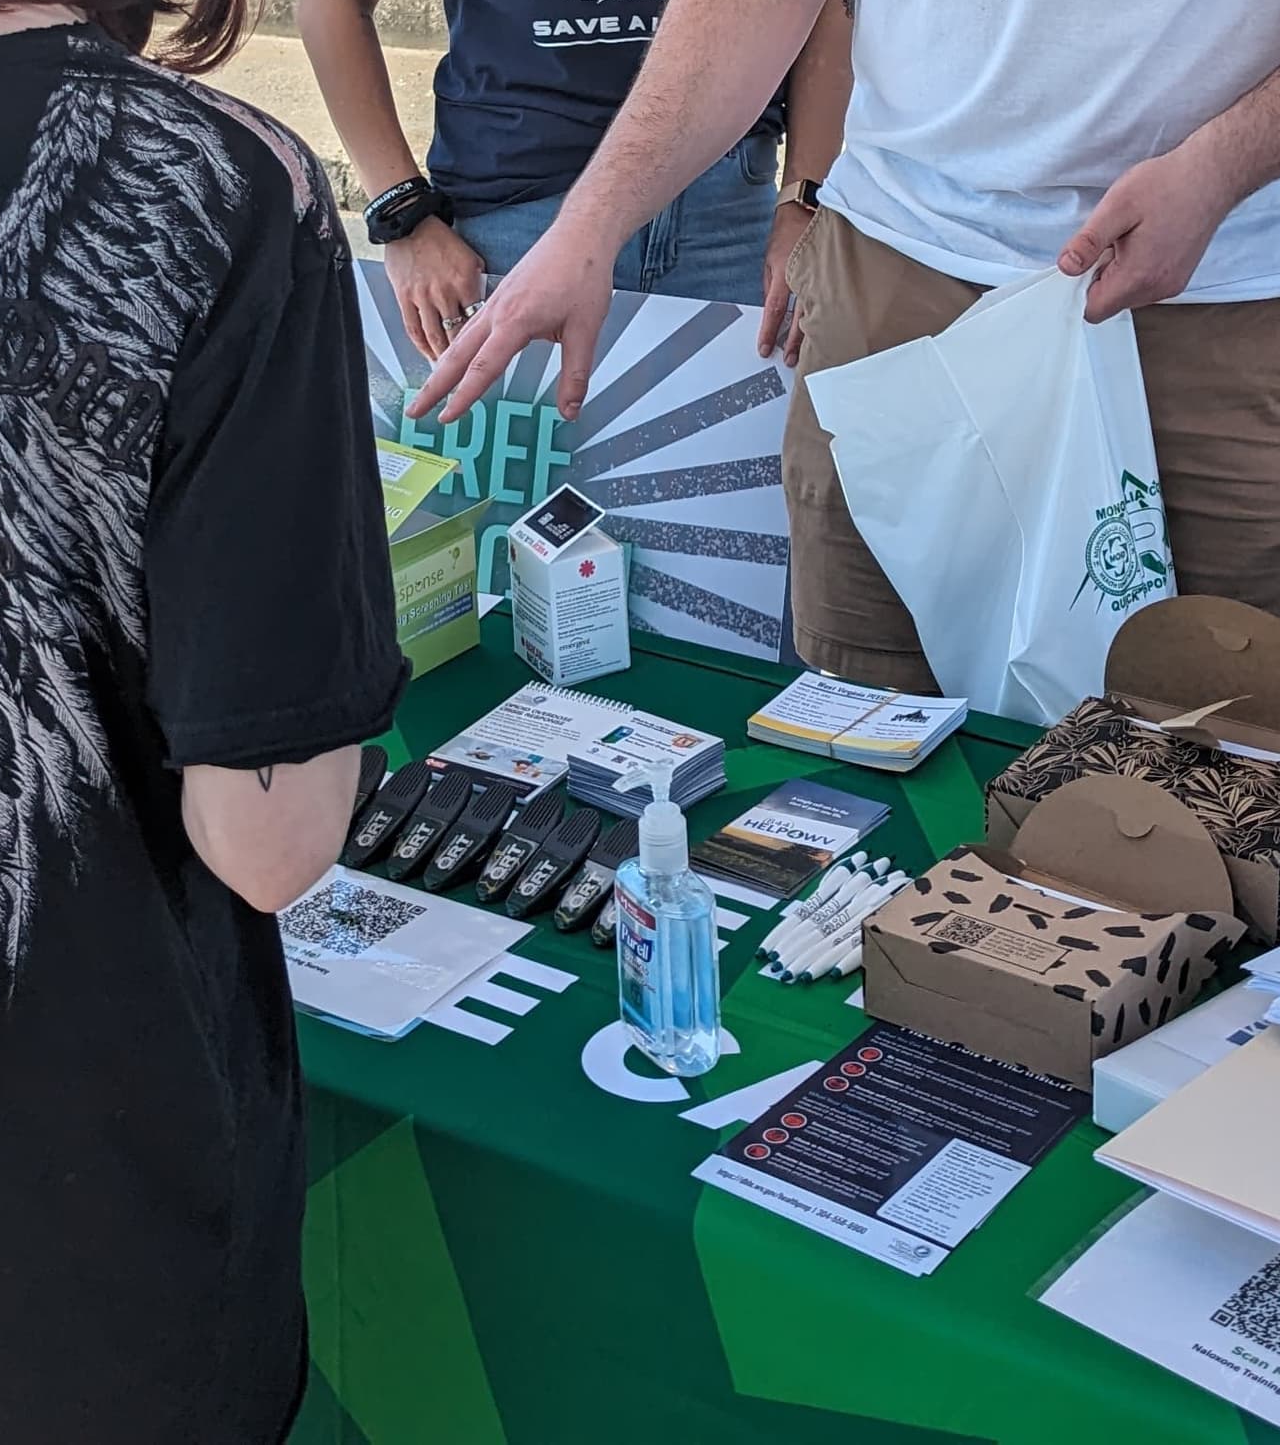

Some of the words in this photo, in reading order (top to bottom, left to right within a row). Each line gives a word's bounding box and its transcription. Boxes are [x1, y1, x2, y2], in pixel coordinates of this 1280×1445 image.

[532, 16, 619, 37] SAVE
[628, 15, 646, 32] A
[400, 387, 577, 507] FREE
[398, 567, 445, 603] sponse
[408, 588, 454, 621] Screening
[816, 681, 836, 692] West
[837, 686, 866, 699] Virginia
[355, 810, 393, 848] QRT
[399, 822, 435, 860] QRT
[437, 833, 474, 871] QRT
[489, 842, 526, 882] QRT
[521, 858, 559, 897] QRT
[621, 922, 650, 962] Purell
[1191, 1342, 1241, 1373] Naloxone
[1231, 1345, 1270, 1370] Scan
